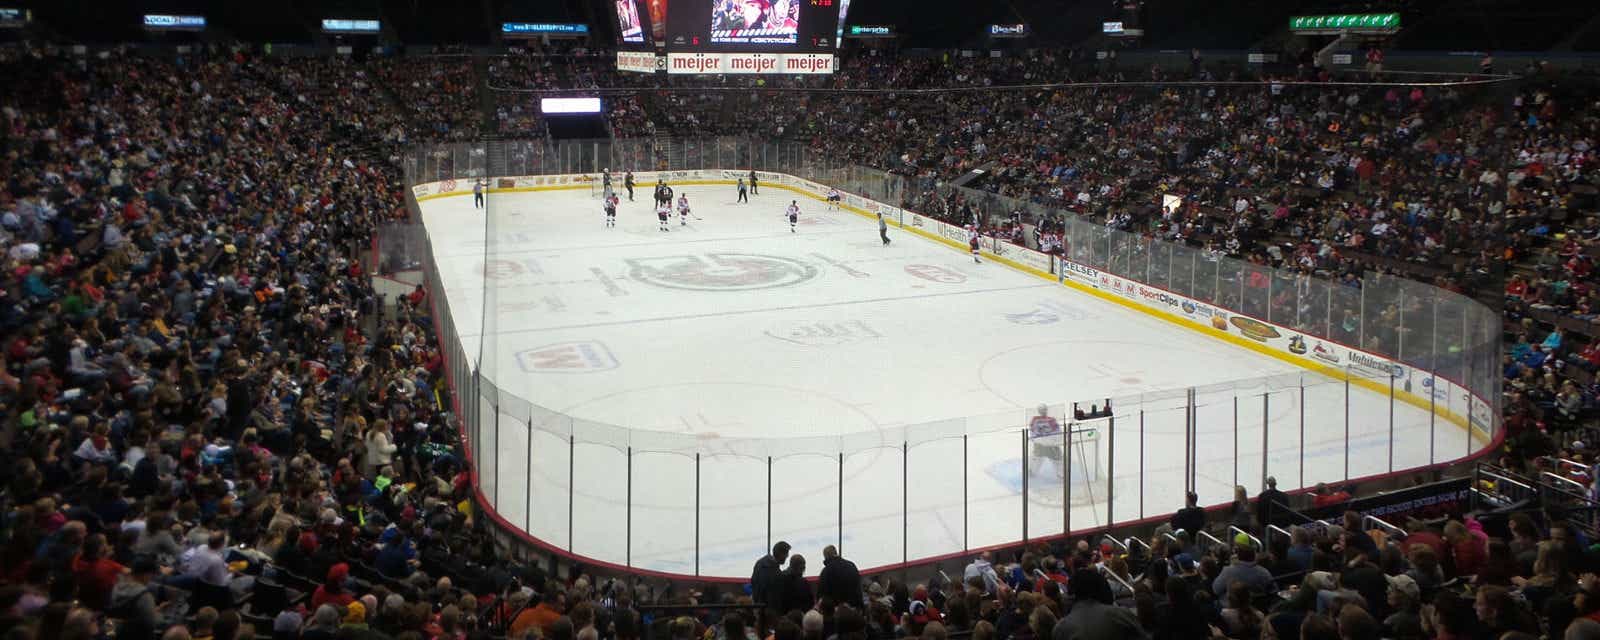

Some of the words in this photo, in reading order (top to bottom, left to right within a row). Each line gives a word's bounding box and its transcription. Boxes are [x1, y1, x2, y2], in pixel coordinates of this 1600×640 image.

[673, 53, 720, 72] meijer
[731, 54, 777, 72] meijer
[787, 54, 830, 73] meijer
[1063, 260, 1099, 278] KELSEY
